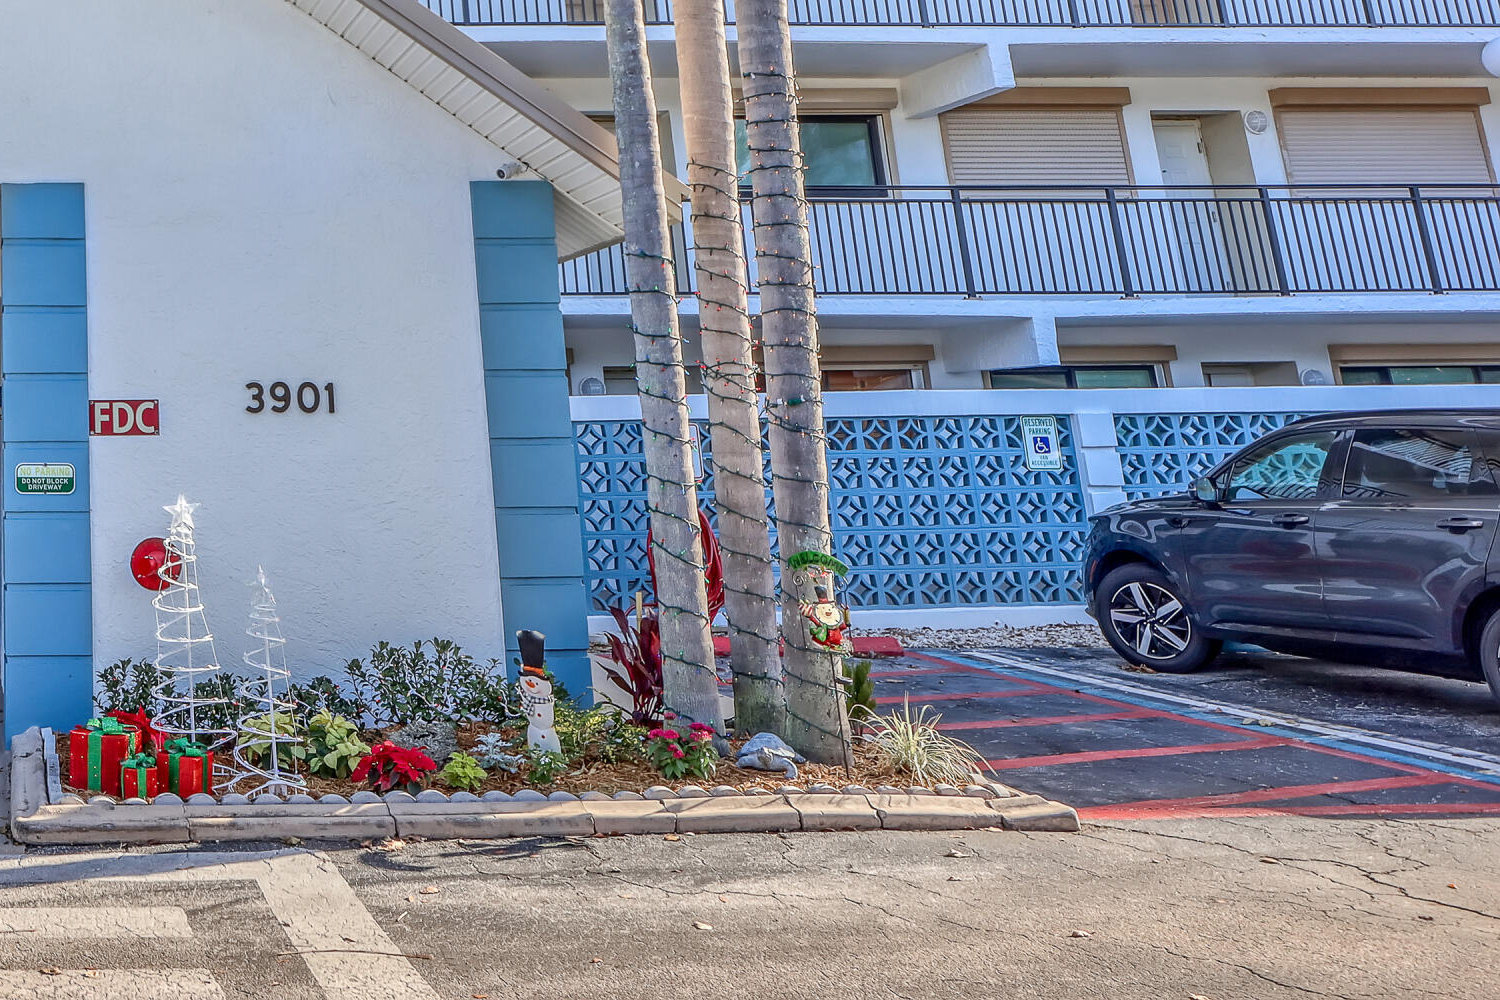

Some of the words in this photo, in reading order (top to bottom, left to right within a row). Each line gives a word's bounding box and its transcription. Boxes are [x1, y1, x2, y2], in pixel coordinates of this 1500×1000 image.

[245, 381, 335, 414] 3901
[94, 401, 155, 434] FDC
[1023, 418, 1053, 427] RESERVED
[1028, 427, 1052, 435] PARKING
[20, 467, 32, 476] NO
[35, 467, 71, 476] PARKING
[791, 551, 846, 576] WELCOME
